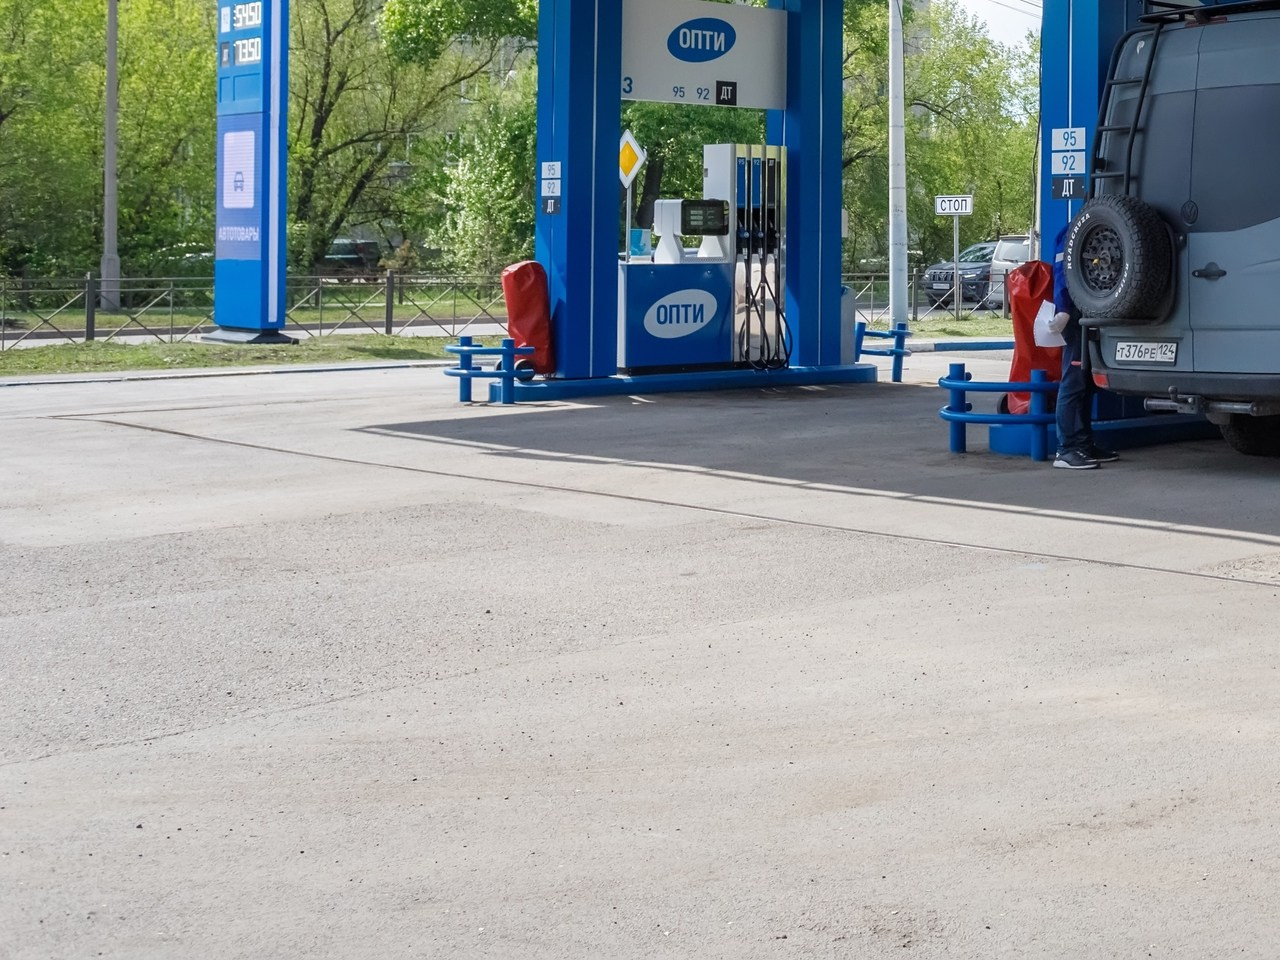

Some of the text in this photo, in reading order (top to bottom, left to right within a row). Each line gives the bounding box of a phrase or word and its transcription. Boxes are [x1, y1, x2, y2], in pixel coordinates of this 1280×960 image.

[679, 28, 726, 52] ОПТИ
[622, 76, 633, 94] 3
[672, 86, 733, 101] 95 92 ДТ
[1063, 131, 1077, 147] 95
[547, 164, 556, 176] 95
[1061, 155, 1076, 171] 92
[547, 182, 556, 194] 92
[1061, 179, 1075, 197] ДТ
[546, 199, 555, 214] ДТ
[940, 199, 968, 211] СТОП
[218, 226, 260, 241] АВТОТОВАРЫ
[1067, 213, 1091, 270] ROADCRUZA
[656, 303, 705, 325] ОПТИ
[1158, 344, 1175, 356] 124
